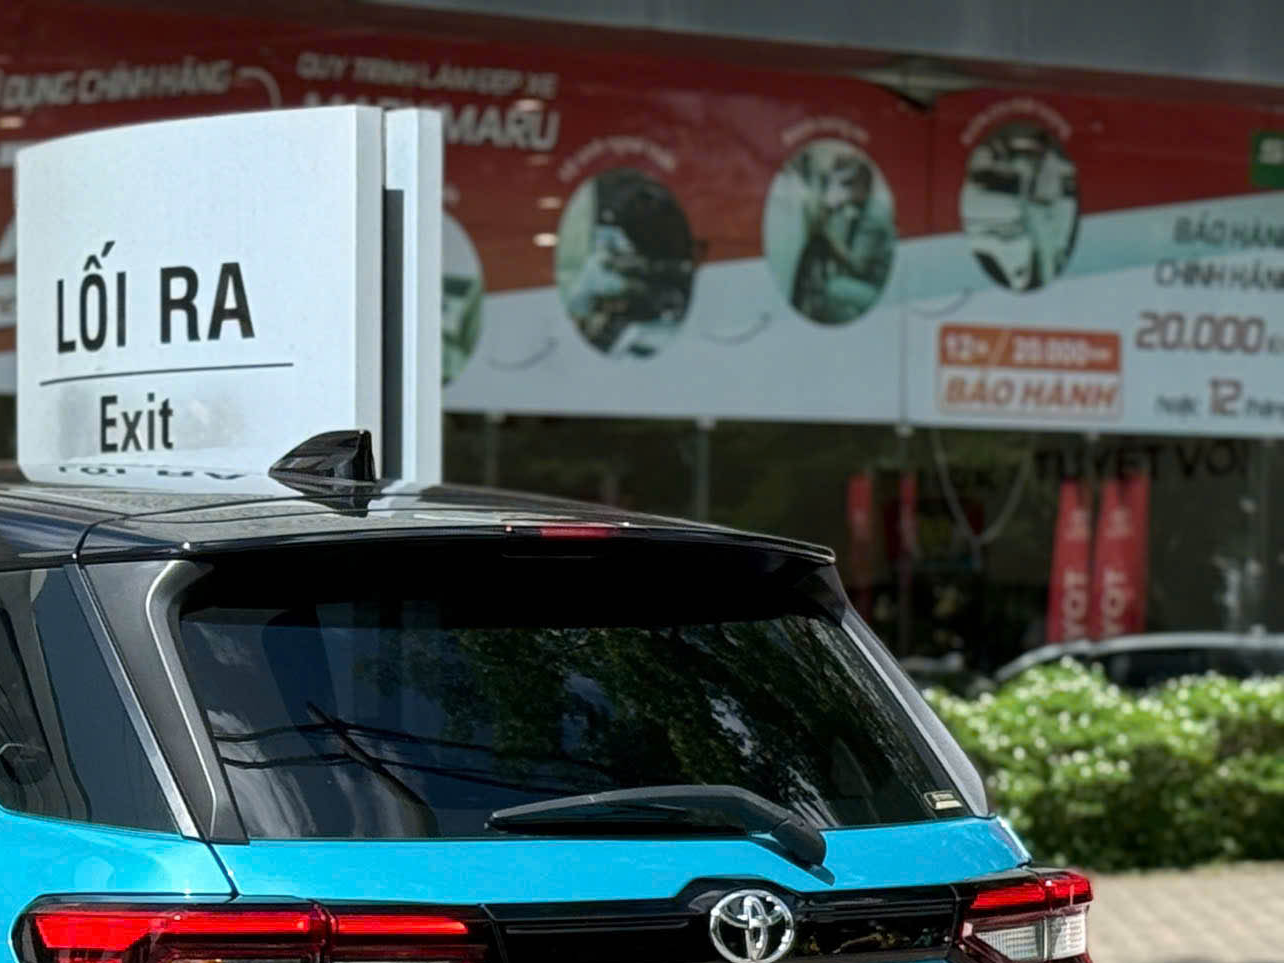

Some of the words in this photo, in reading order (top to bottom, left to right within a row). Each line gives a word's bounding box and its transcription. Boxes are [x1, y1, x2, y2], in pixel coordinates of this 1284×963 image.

[56, 240, 127, 354] LỐI
[159, 261, 256, 345] RA
[1135, 310, 1266, 355] 20.000
[100, 391, 174, 454] Exit
[1208, 377, 1243, 416] 12
